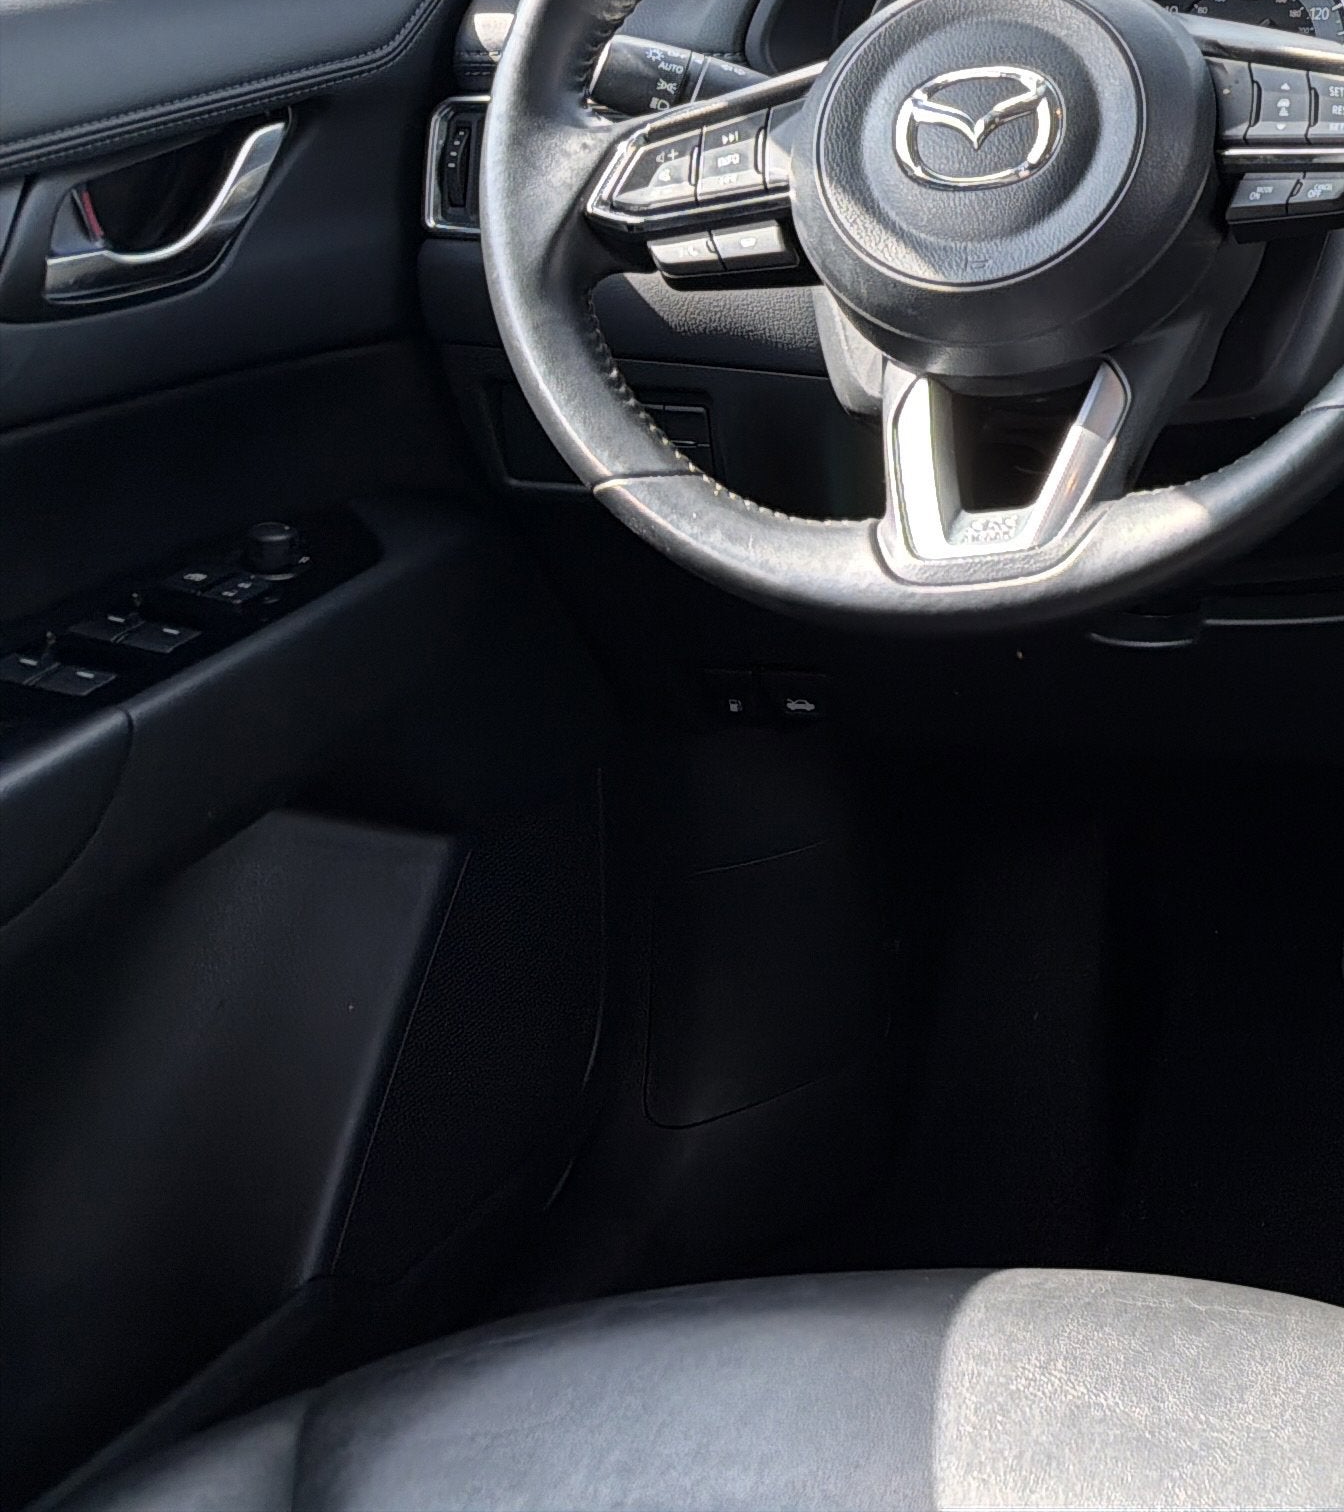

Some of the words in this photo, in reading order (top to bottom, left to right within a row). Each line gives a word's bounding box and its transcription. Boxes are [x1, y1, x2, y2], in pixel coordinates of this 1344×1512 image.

[1308, 6, 1330, 21] 120
[658, 61, 684, 75] AUTO
[1307, 189, 1323, 199] OFF
